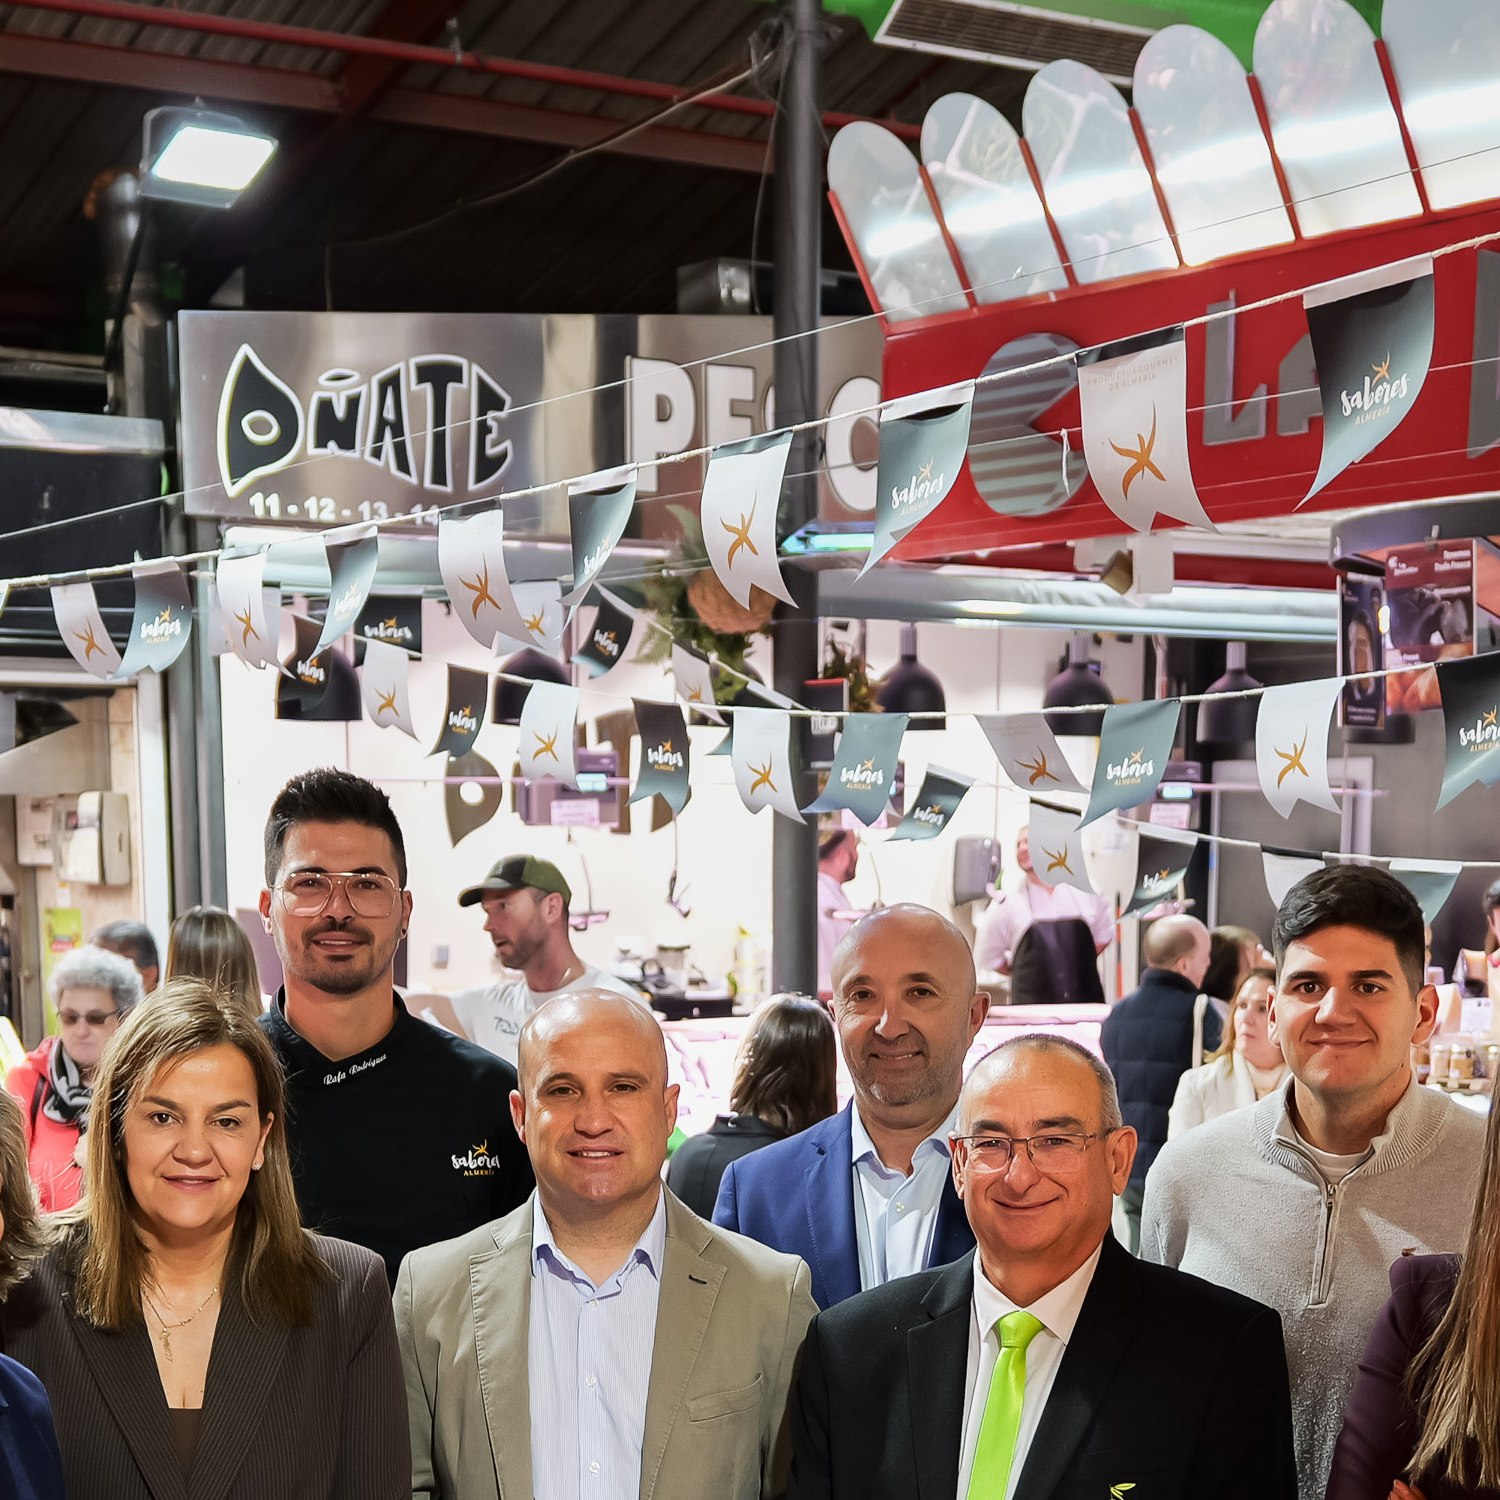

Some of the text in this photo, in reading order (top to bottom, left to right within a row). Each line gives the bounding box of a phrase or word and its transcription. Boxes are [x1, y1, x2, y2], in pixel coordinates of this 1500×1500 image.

[1340, 372, 1411, 416] sabores
[891, 472, 946, 510] sabores
[248, 491, 279, 518] 11
[304, 496, 336, 522] 12
[840, 763, 884, 785] sabores
[1106, 756, 1155, 780] sabores
[323, 1070, 347, 1086] Rafa
